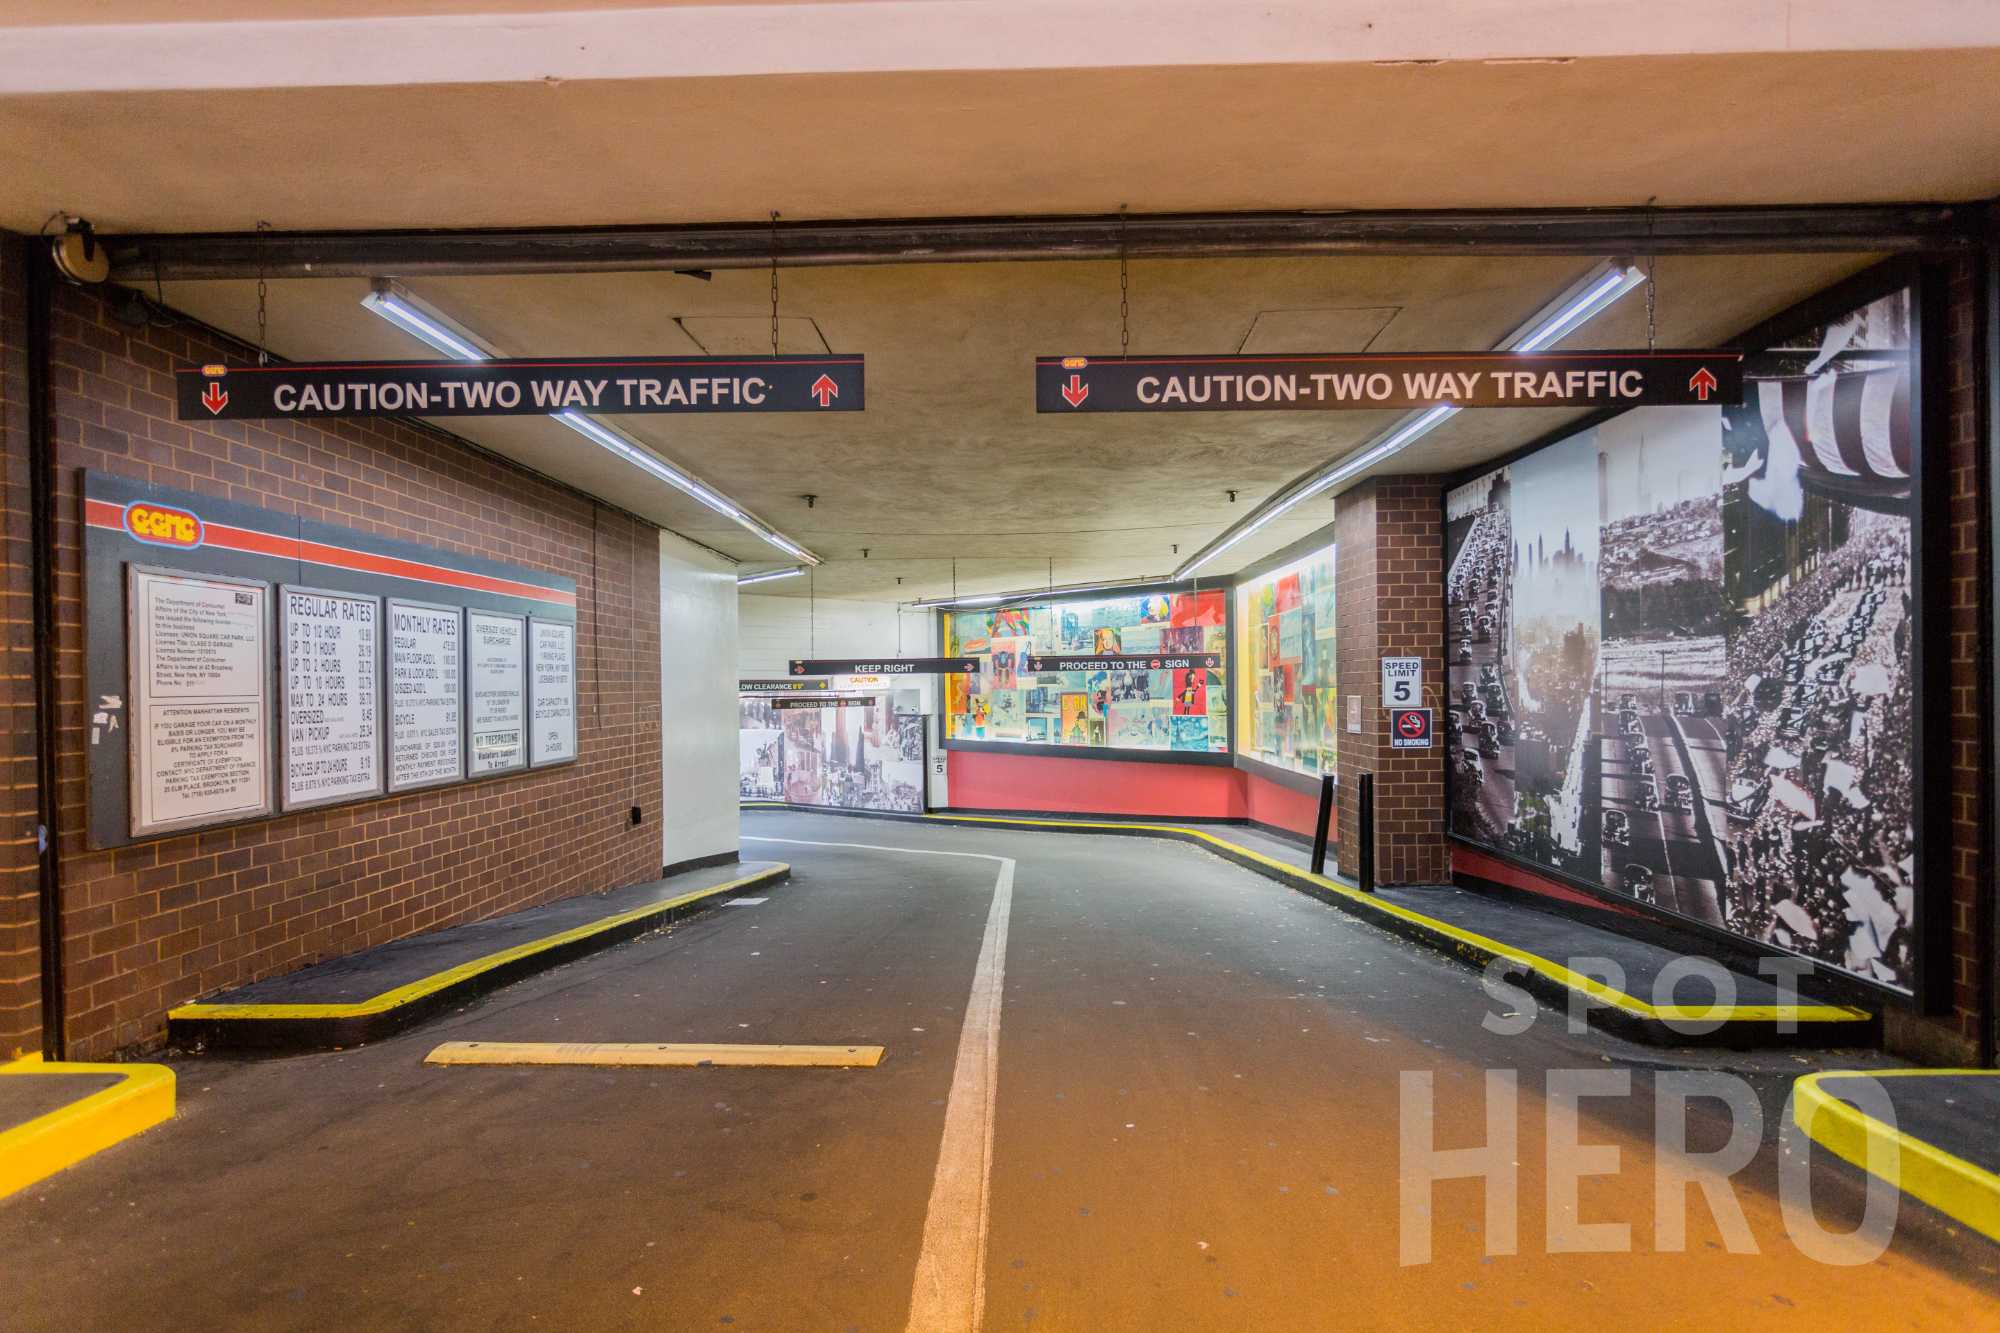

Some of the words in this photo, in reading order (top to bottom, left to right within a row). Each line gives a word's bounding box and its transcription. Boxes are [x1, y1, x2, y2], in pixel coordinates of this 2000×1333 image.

[273, 380, 521, 411] CAUTION-TWO
[531, 380, 608, 407] WAY
[616, 377, 766, 406] TRAFFIC
[1136, 373, 1392, 403] CAUTION-TWO
[1402, 372, 1481, 400] WAY
[1490, 370, 1643, 398] TRAFFIC
[290, 596, 338, 620] REGULAR
[342, 602, 372, 622] RATES
[290, 622, 299, 636] UP
[302, 623, 311, 638] TO
[324, 625, 341, 640] HOUR
[394, 613, 431, 633] MONTHLY
[432, 617, 456, 636] RATES
[290, 640, 299, 654] UP
[302, 640, 311, 655] TO
[320, 641, 336, 656] HOUR
[394, 636, 417, 649] REGULAR
[290, 657, 299, 672] UP
[302, 658, 311, 672] TO
[321, 658, 341, 673] HOURS
[854, 664, 881, 673] KEEP
[883, 663, 915, 673] RIGHT
[1059, 661, 1109, 670] PROCEED
[1110, 661, 1125, 670] TO
[1126, 660, 1147, 669] THE
[1164, 658, 1190, 668] SIGN
[1385, 662, 1419, 670] SPEED
[1387, 669, 1417, 677] LIMIT
[291, 675, 299, 690] UP
[303, 675, 311, 690] TO
[315, 675, 322, 689] 10
[325, 675, 345, 690] HOURS
[1393, 681, 1411, 701] 5
[291, 693, 304, 707] MAX
[306, 693, 314, 707] TO
[318, 693, 325, 707] 24
[327, 693, 348, 707] HOURS
[291, 710, 324, 725] OVERSIZED
[395, 713, 415, 726] BICYCLE
[291, 727, 304, 742] VAN
[308, 726, 330, 740] PICKUP
[1403, 738, 1429, 746] SMOKING
[936, 764, 944, 773] 5
